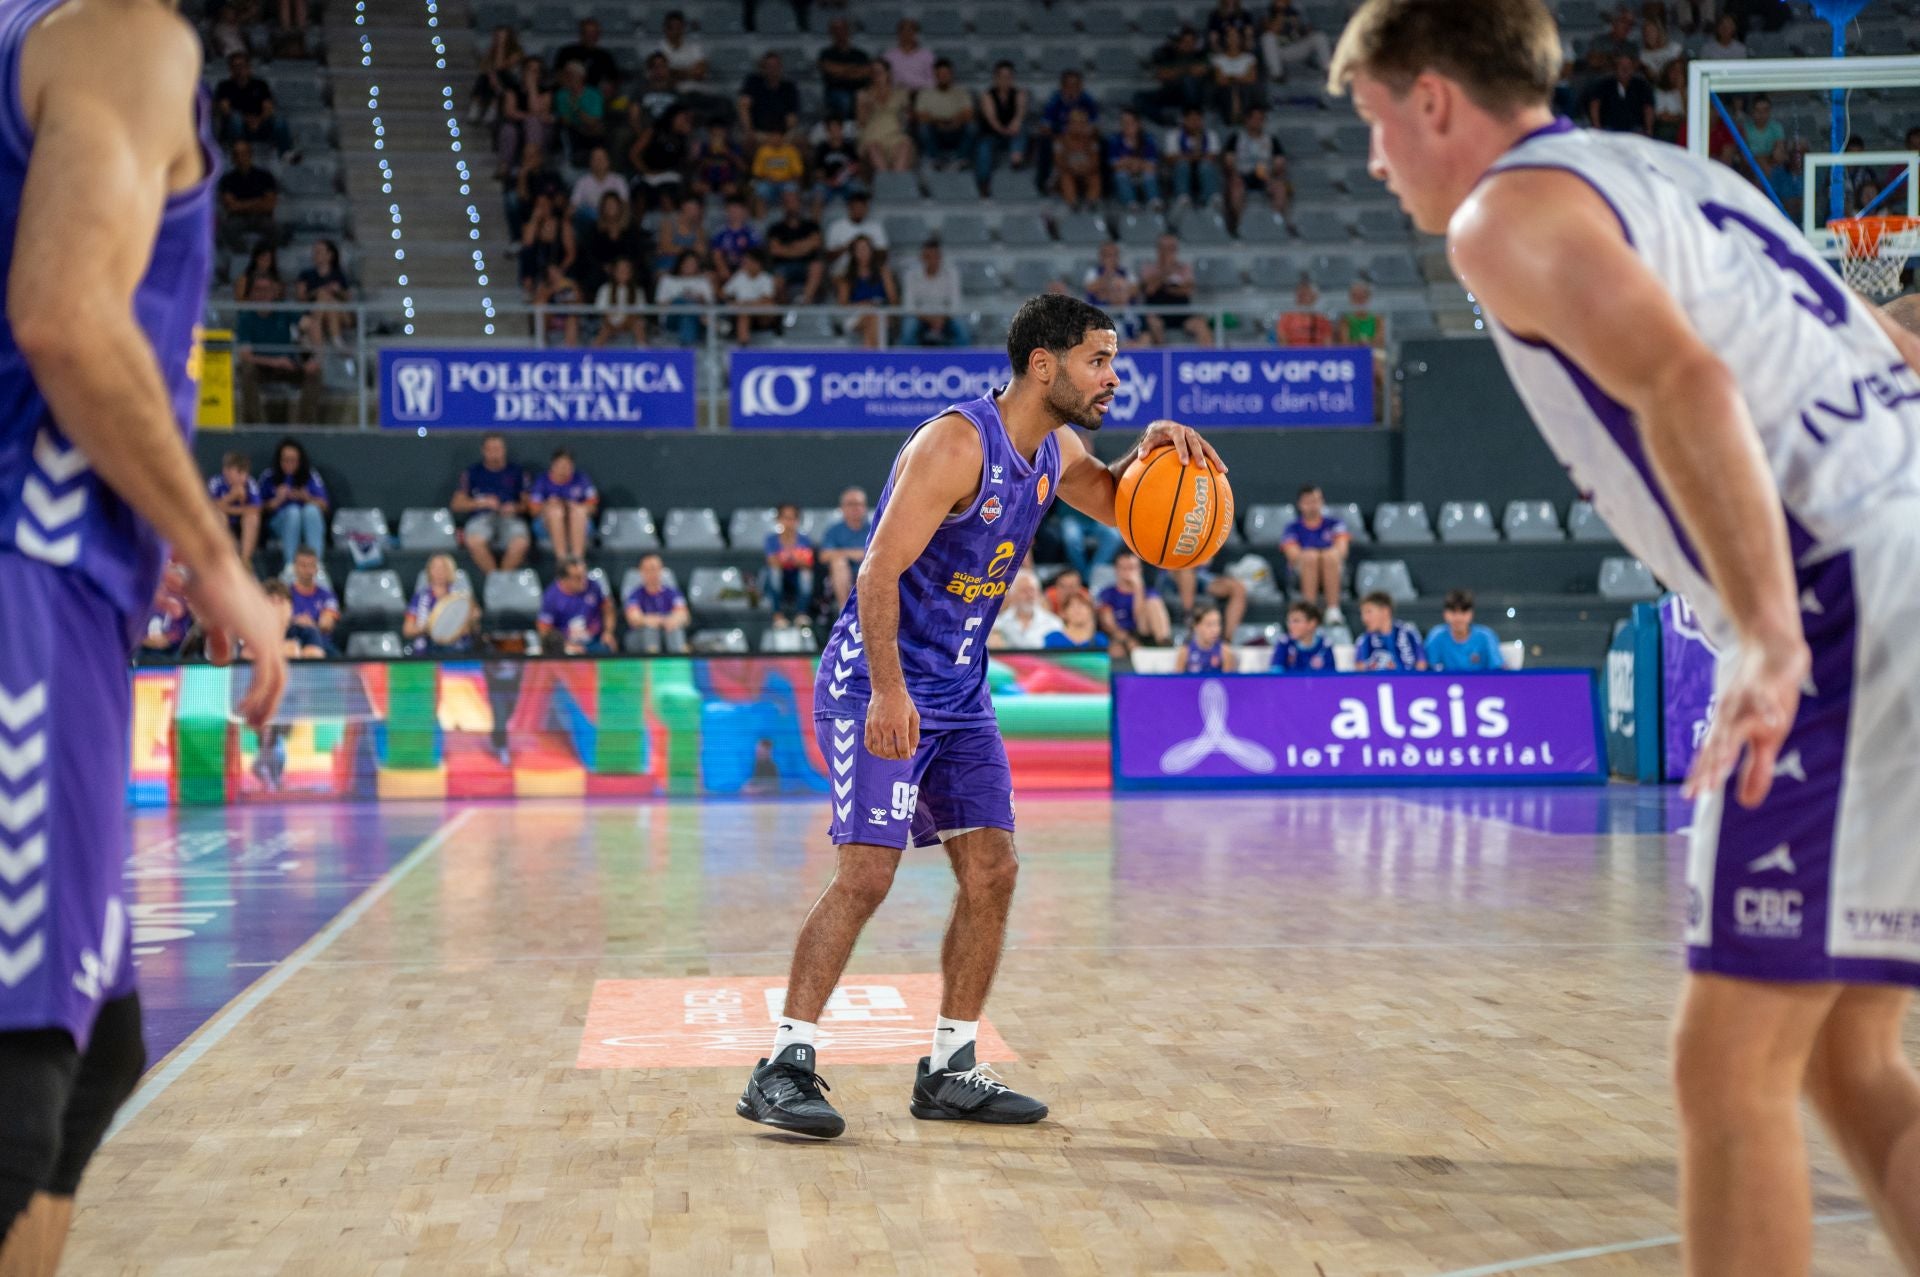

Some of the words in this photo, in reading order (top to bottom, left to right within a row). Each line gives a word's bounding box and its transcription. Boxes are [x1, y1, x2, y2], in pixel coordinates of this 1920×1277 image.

[1698, 200, 1847, 328] 3
[449, 355, 683, 393] POLICLÍNICA
[1178, 360, 1252, 384] sara
[1260, 358, 1355, 383] varas
[493, 393, 642, 422] DENTAL
[1271, 382, 1355, 413] dental
[1173, 475, 1209, 556] Wilson
[953, 571, 982, 584] súper
[1330, 683, 1509, 739] alsis
[1286, 743, 1345, 767] IoT
[1362, 741, 1554, 767] Industrial
